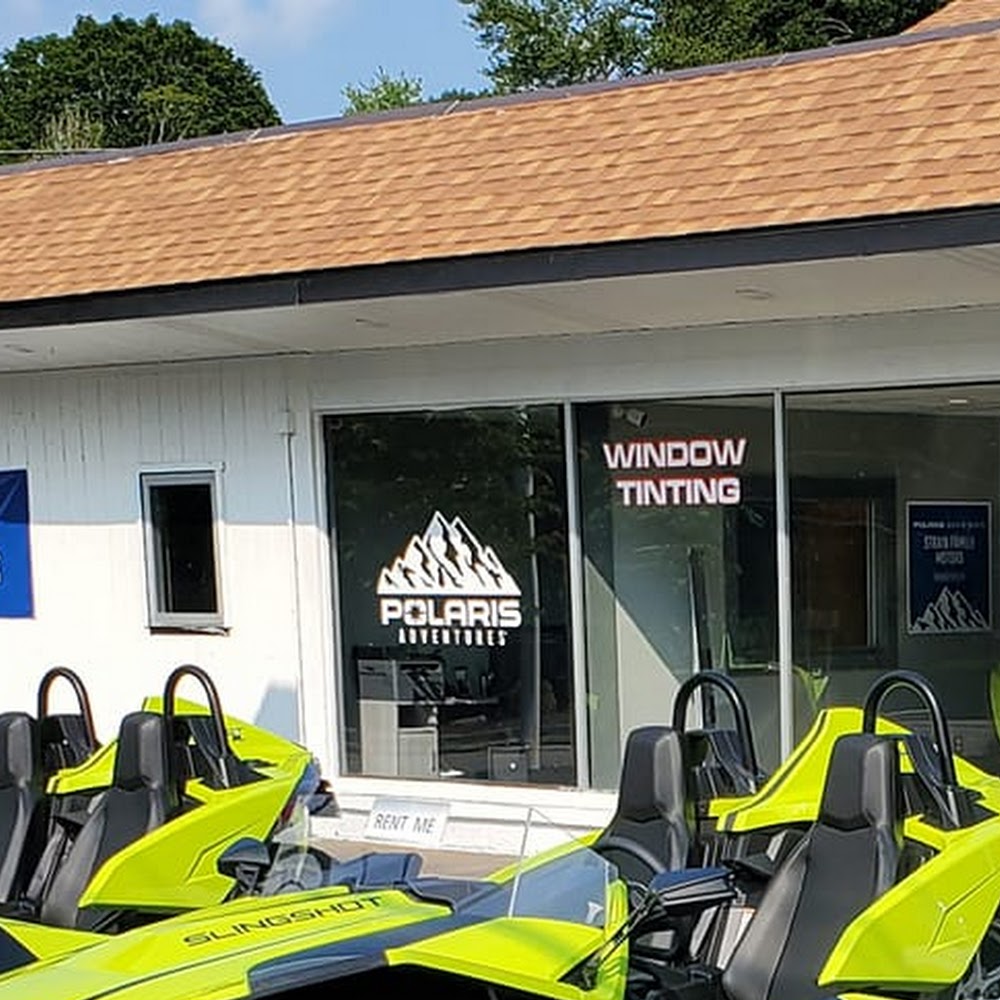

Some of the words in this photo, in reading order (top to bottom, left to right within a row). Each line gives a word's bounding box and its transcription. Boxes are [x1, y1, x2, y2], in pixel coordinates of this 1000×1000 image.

[602, 437, 747, 469] WINDOW
[615, 476, 741, 506] TINTING
[380, 598, 522, 628] POLARIS
[374, 812, 407, 832] RENT
[413, 816, 436, 834] ME
[183, 895, 384, 947] SLINGSHOT
